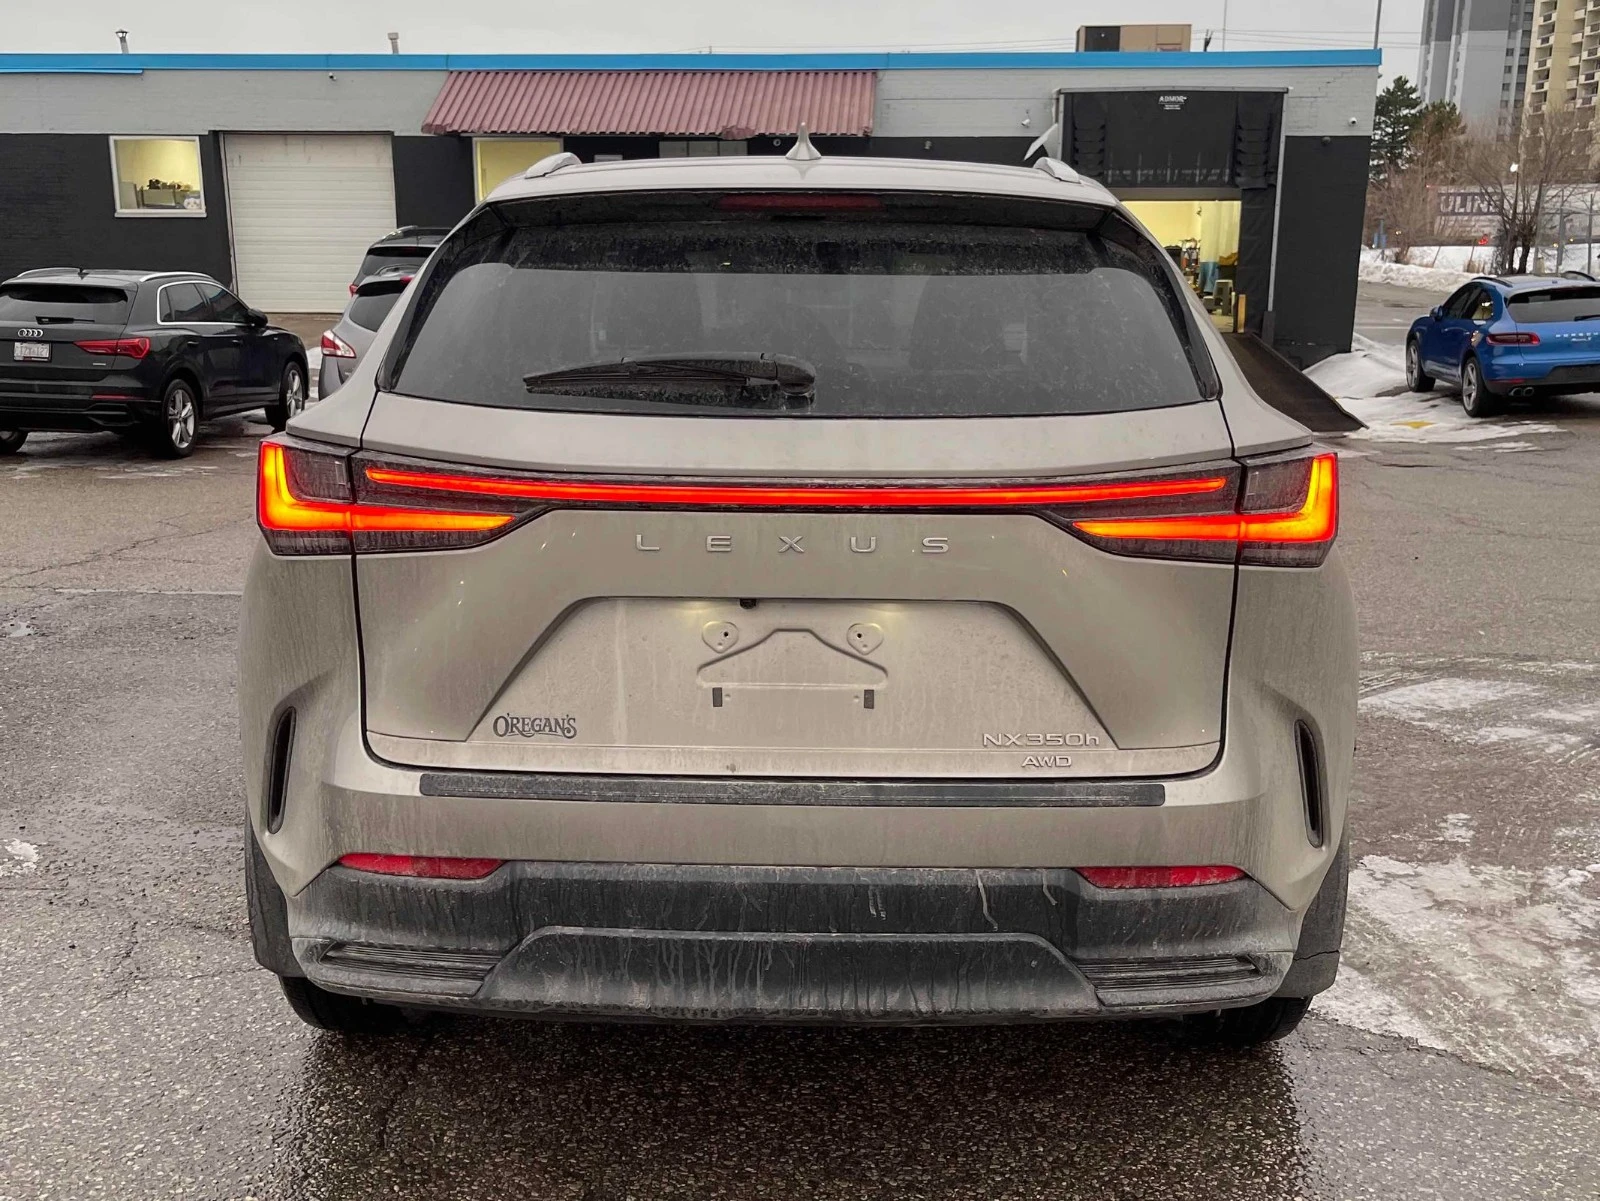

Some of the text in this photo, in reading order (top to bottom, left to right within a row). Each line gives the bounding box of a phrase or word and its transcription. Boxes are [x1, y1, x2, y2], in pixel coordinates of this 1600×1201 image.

[635, 533, 950, 554] LEXUS
[493, 713, 578, 739] O'REGAN'S
[1021, 755, 1073, 768] AWD
